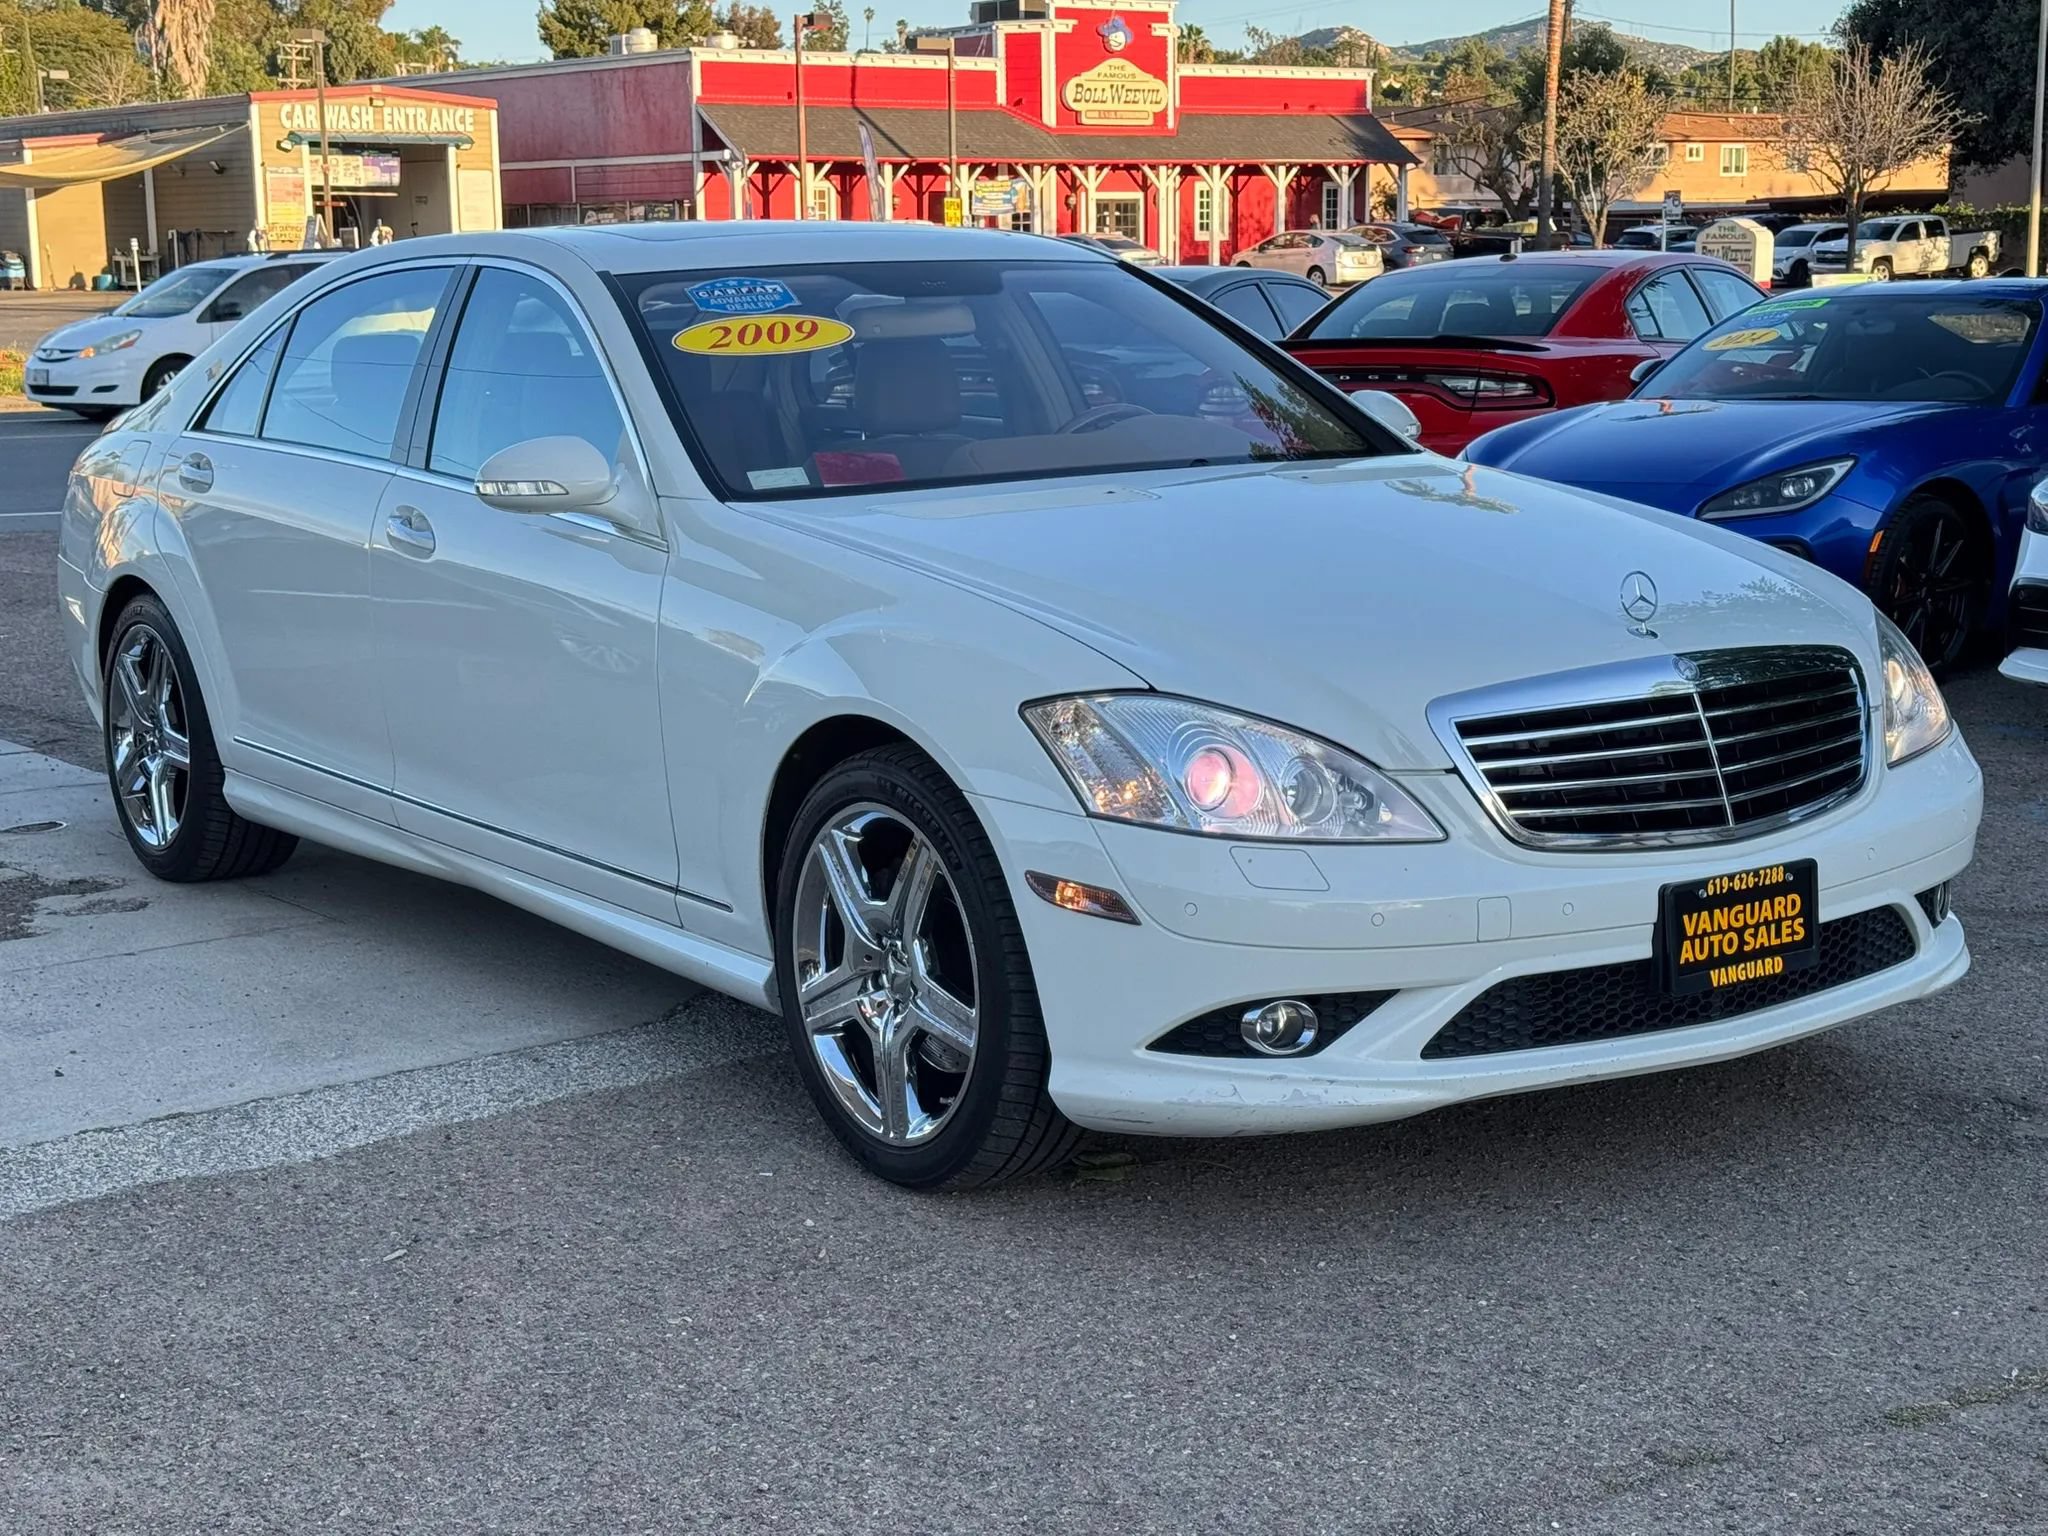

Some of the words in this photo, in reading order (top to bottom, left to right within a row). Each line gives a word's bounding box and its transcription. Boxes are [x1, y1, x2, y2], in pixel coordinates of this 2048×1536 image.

[280, 104, 319, 129] CAR
[324, 105, 374, 131] WASH
[383, 107, 475, 132] ENTRANCE
[697, 284, 783, 298] CARFAX
[709, 293, 782, 306] ADVANTAGE
[726, 301, 775, 311] DEALER
[708, 319, 819, 350] 2009
[1683, 893, 1801, 937] VANGUARD
[1679, 931, 1739, 964] AUTO
[1743, 917, 1805, 951] SALES
[1710, 956, 1784, 988] VANGUARD
